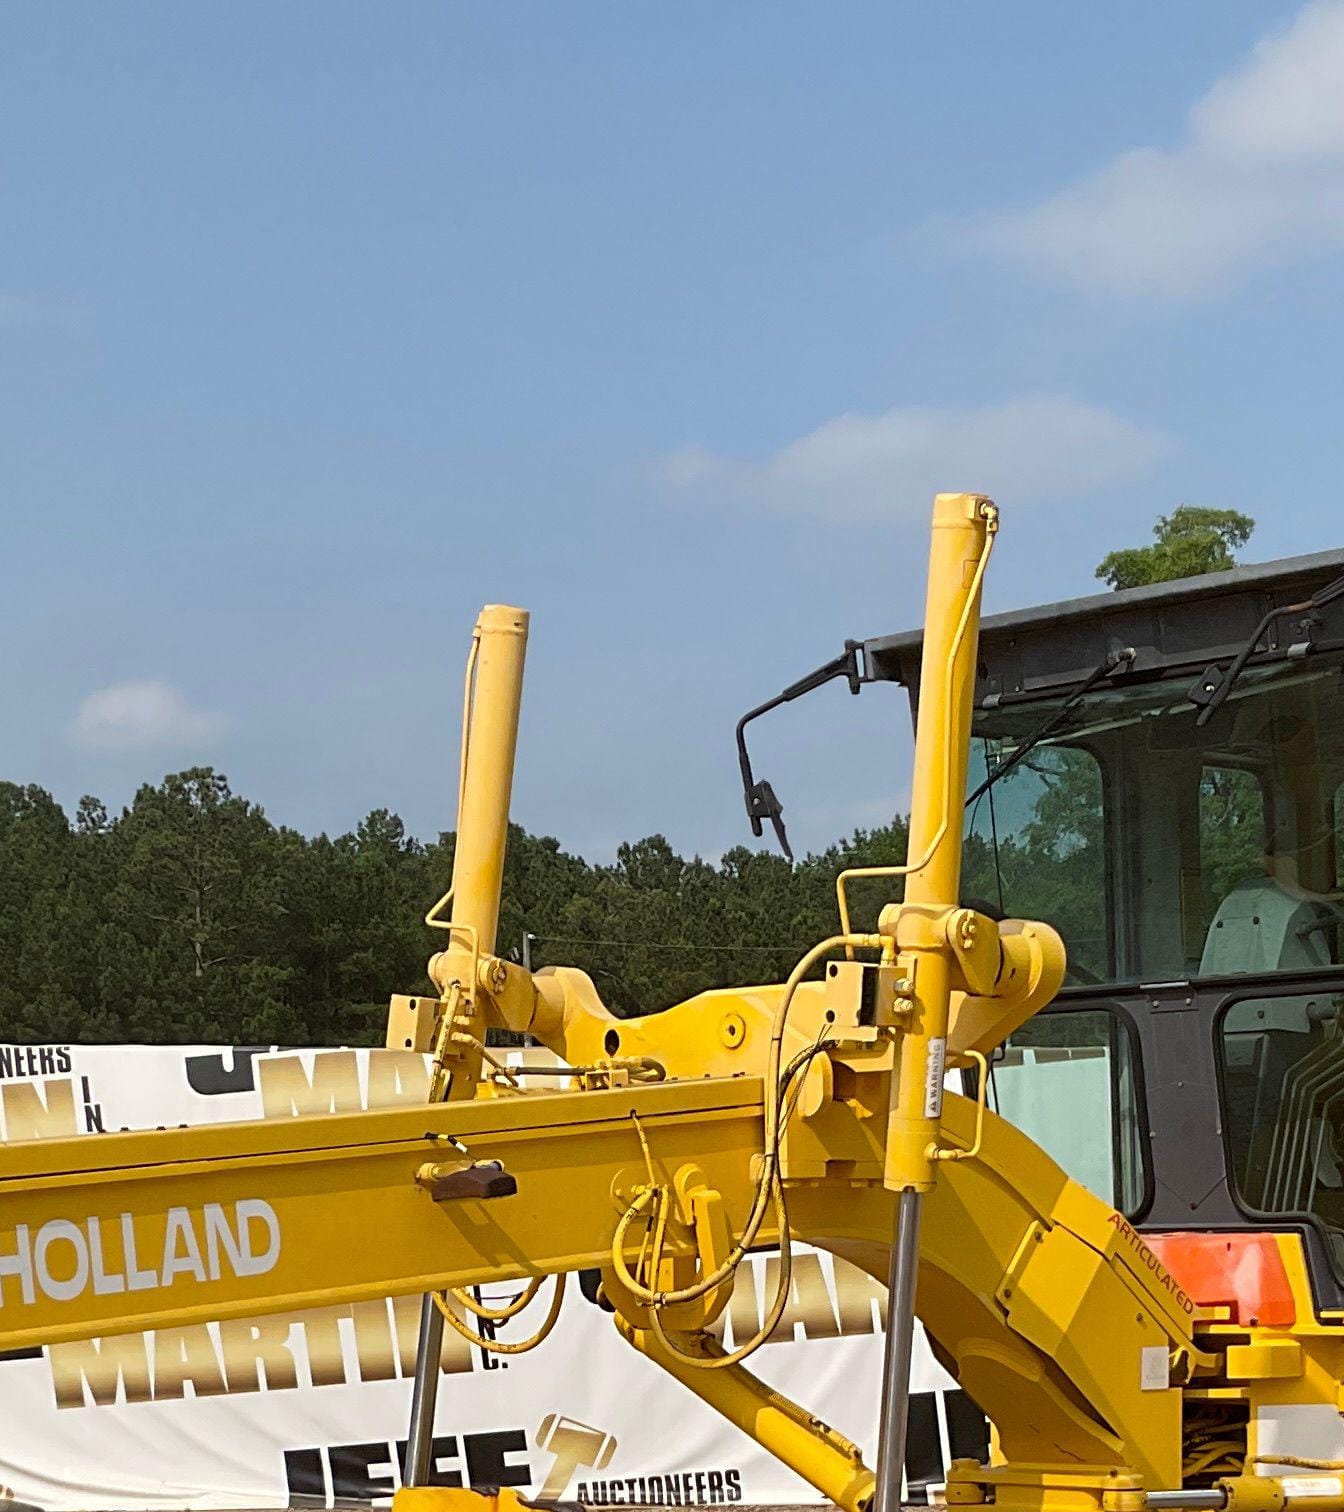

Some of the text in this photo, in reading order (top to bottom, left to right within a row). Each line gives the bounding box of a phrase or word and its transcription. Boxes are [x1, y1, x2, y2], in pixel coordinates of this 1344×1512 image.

[929, 1043, 942, 1100] WARNING
[1107, 1212, 1194, 1315] ARTICULATED
[47, 1293, 475, 1410] MARTIN
[577, 1469, 742, 1508] AUCTIONEERS
